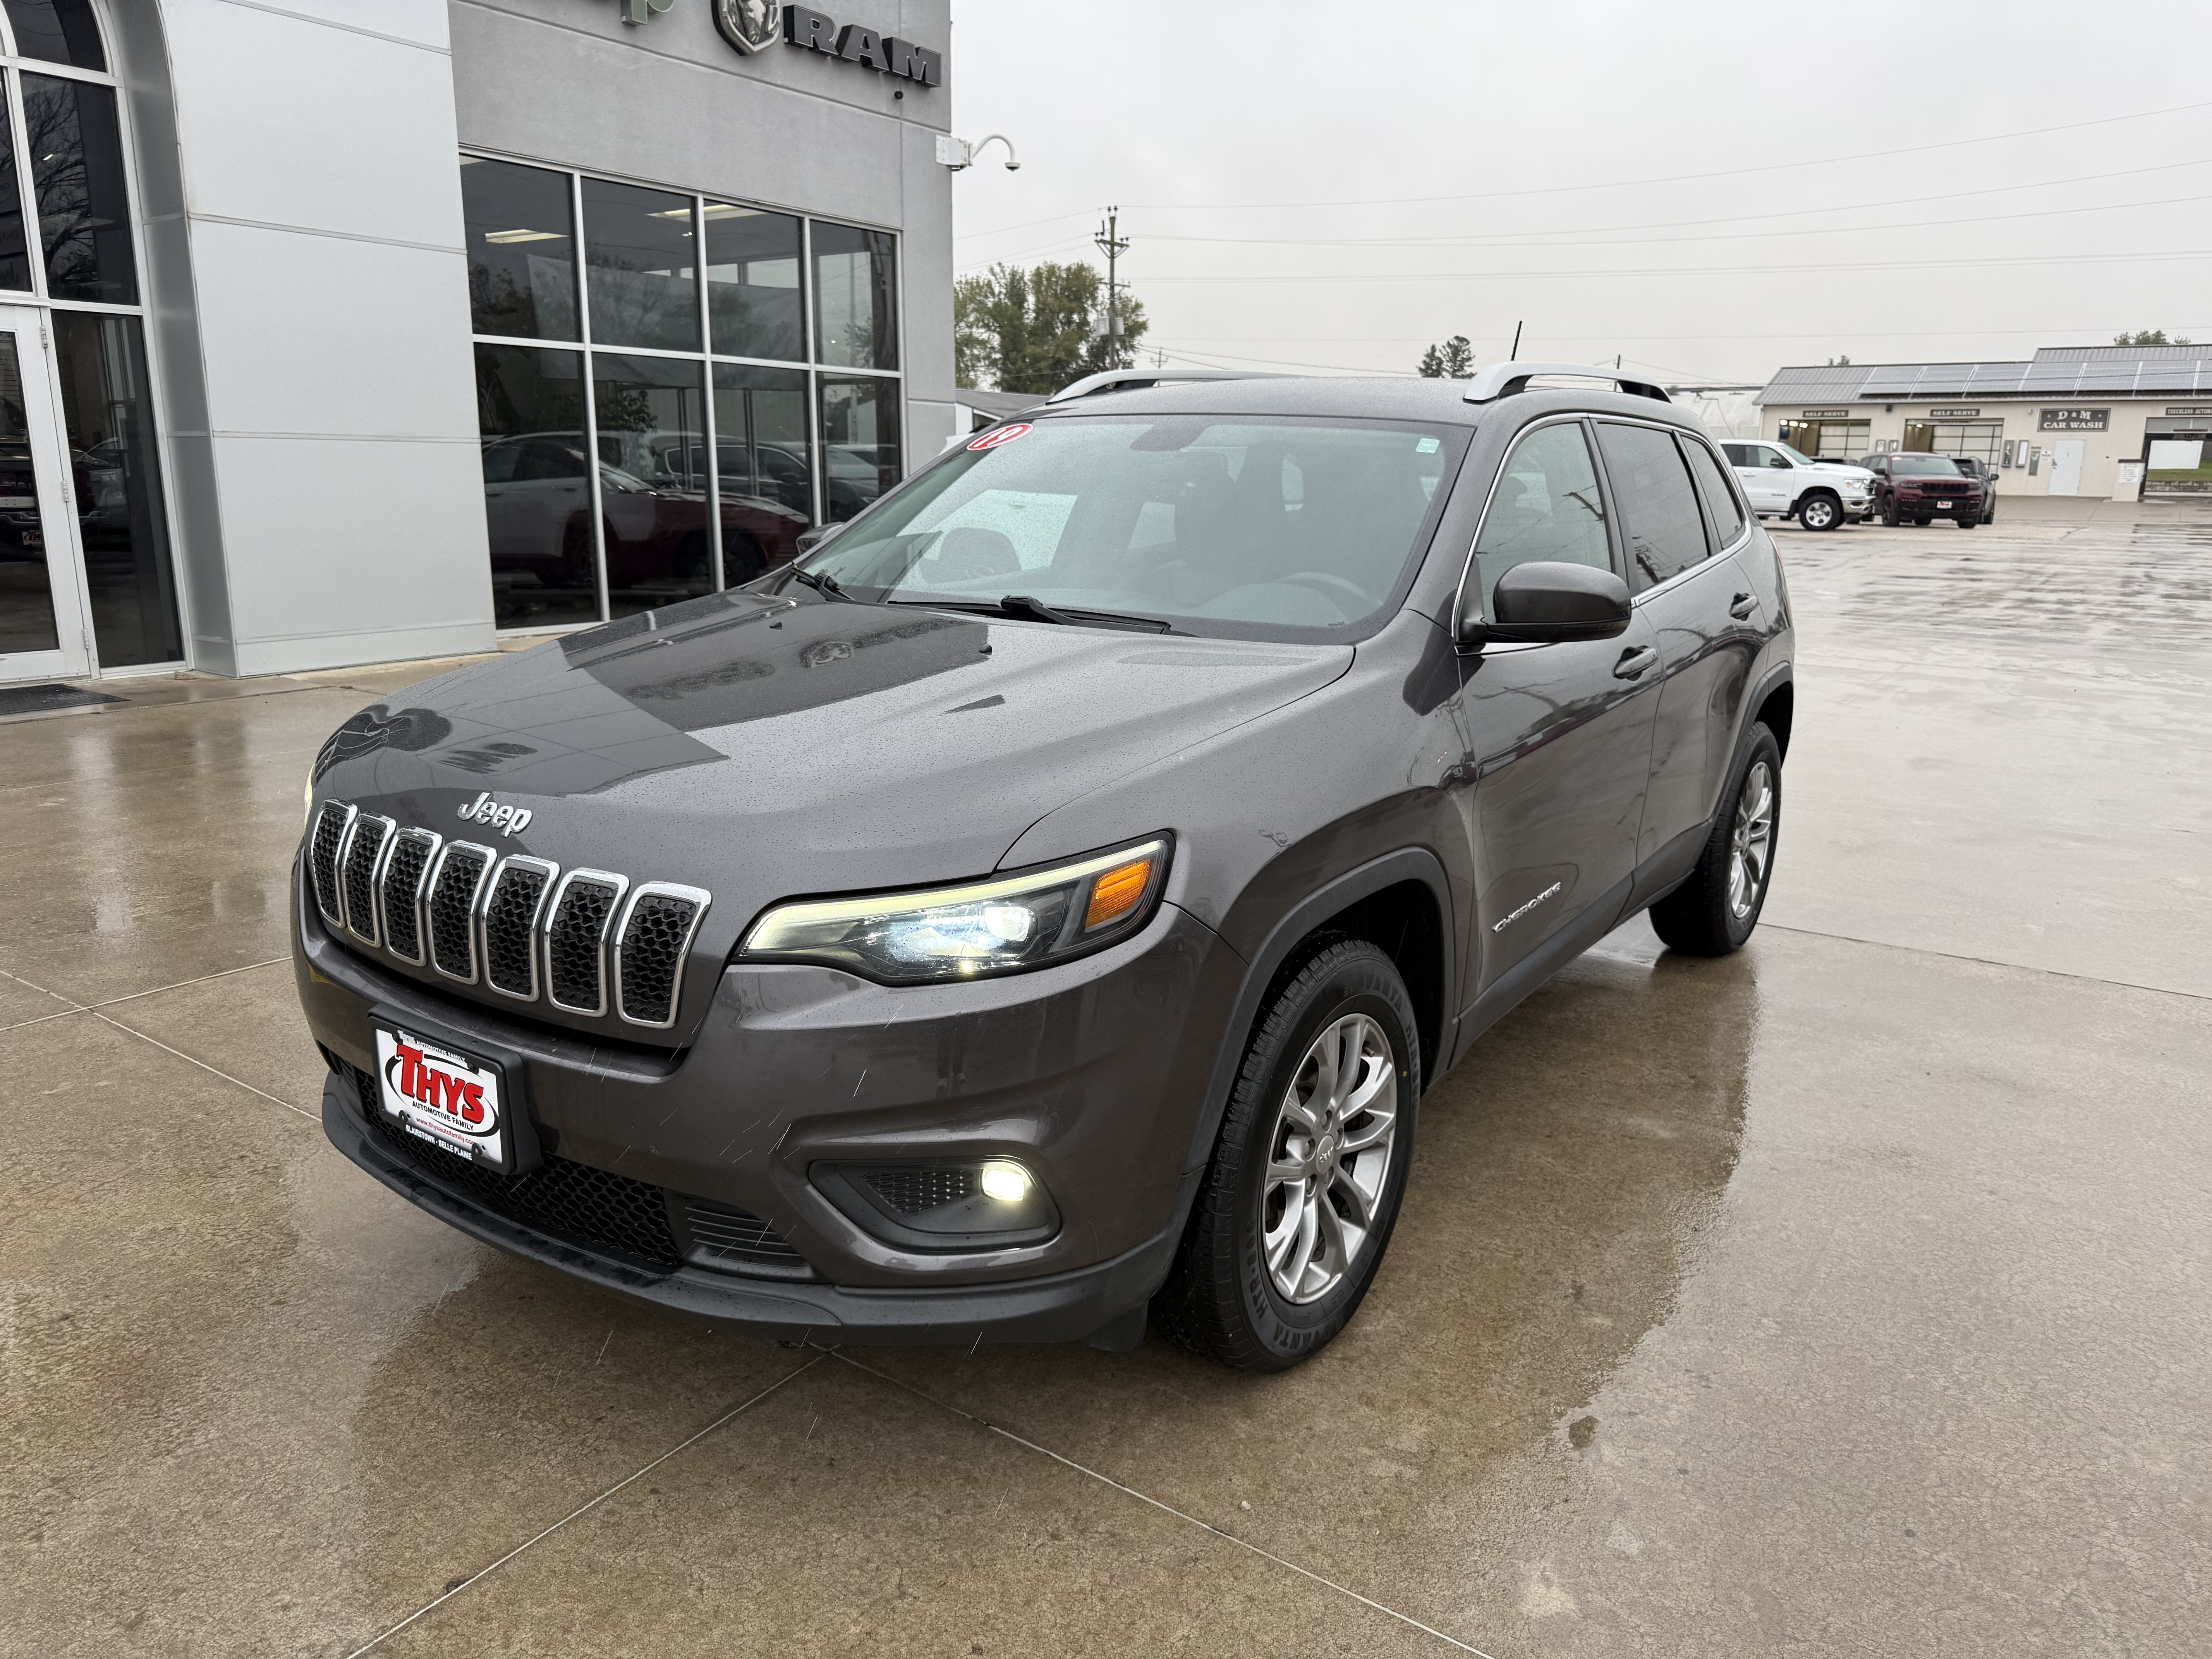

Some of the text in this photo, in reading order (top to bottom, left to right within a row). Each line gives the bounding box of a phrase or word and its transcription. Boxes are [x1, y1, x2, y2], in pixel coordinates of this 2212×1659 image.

[783, 4, 942, 88] RAM
[2057, 411, 2068, 420] D
[2079, 410, 2092, 420] M
[457, 792, 532, 838] Jeep
[447, 1052, 465, 1063] FAMILY
[396, 1044, 484, 1124] THYS
[412, 1101, 474, 1131] AUTOMOTIVE FAMILY
[405, 1124, 472, 1161] BLAIRSTOWN BELLE PLAINE
